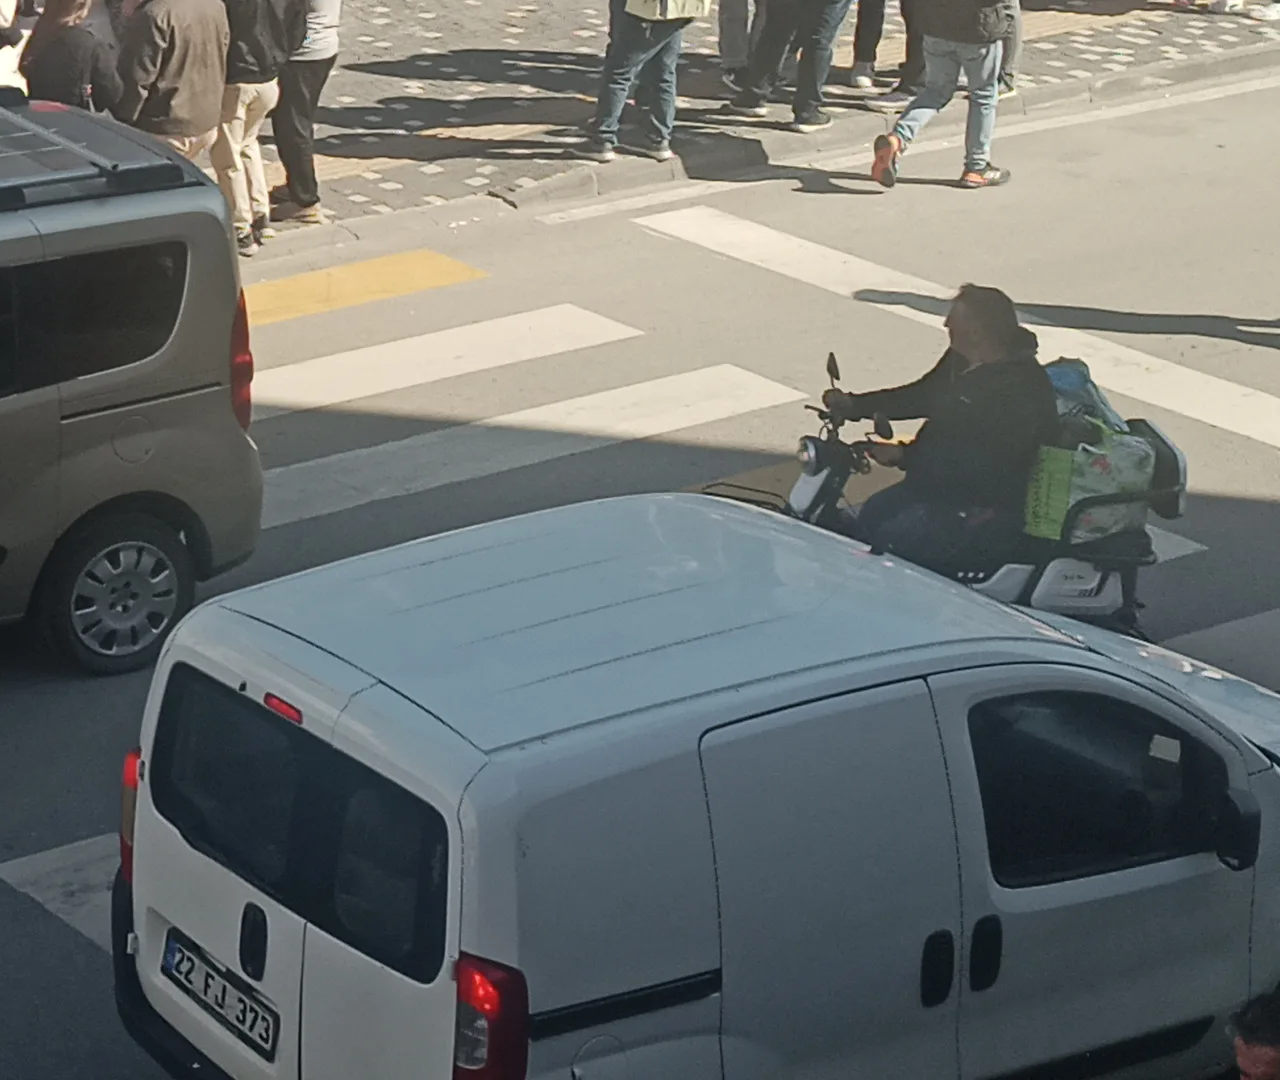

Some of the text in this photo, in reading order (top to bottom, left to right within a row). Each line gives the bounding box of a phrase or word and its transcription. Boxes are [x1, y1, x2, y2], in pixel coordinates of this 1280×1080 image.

[175, 946, 271, 1046] 22 FJ 373
